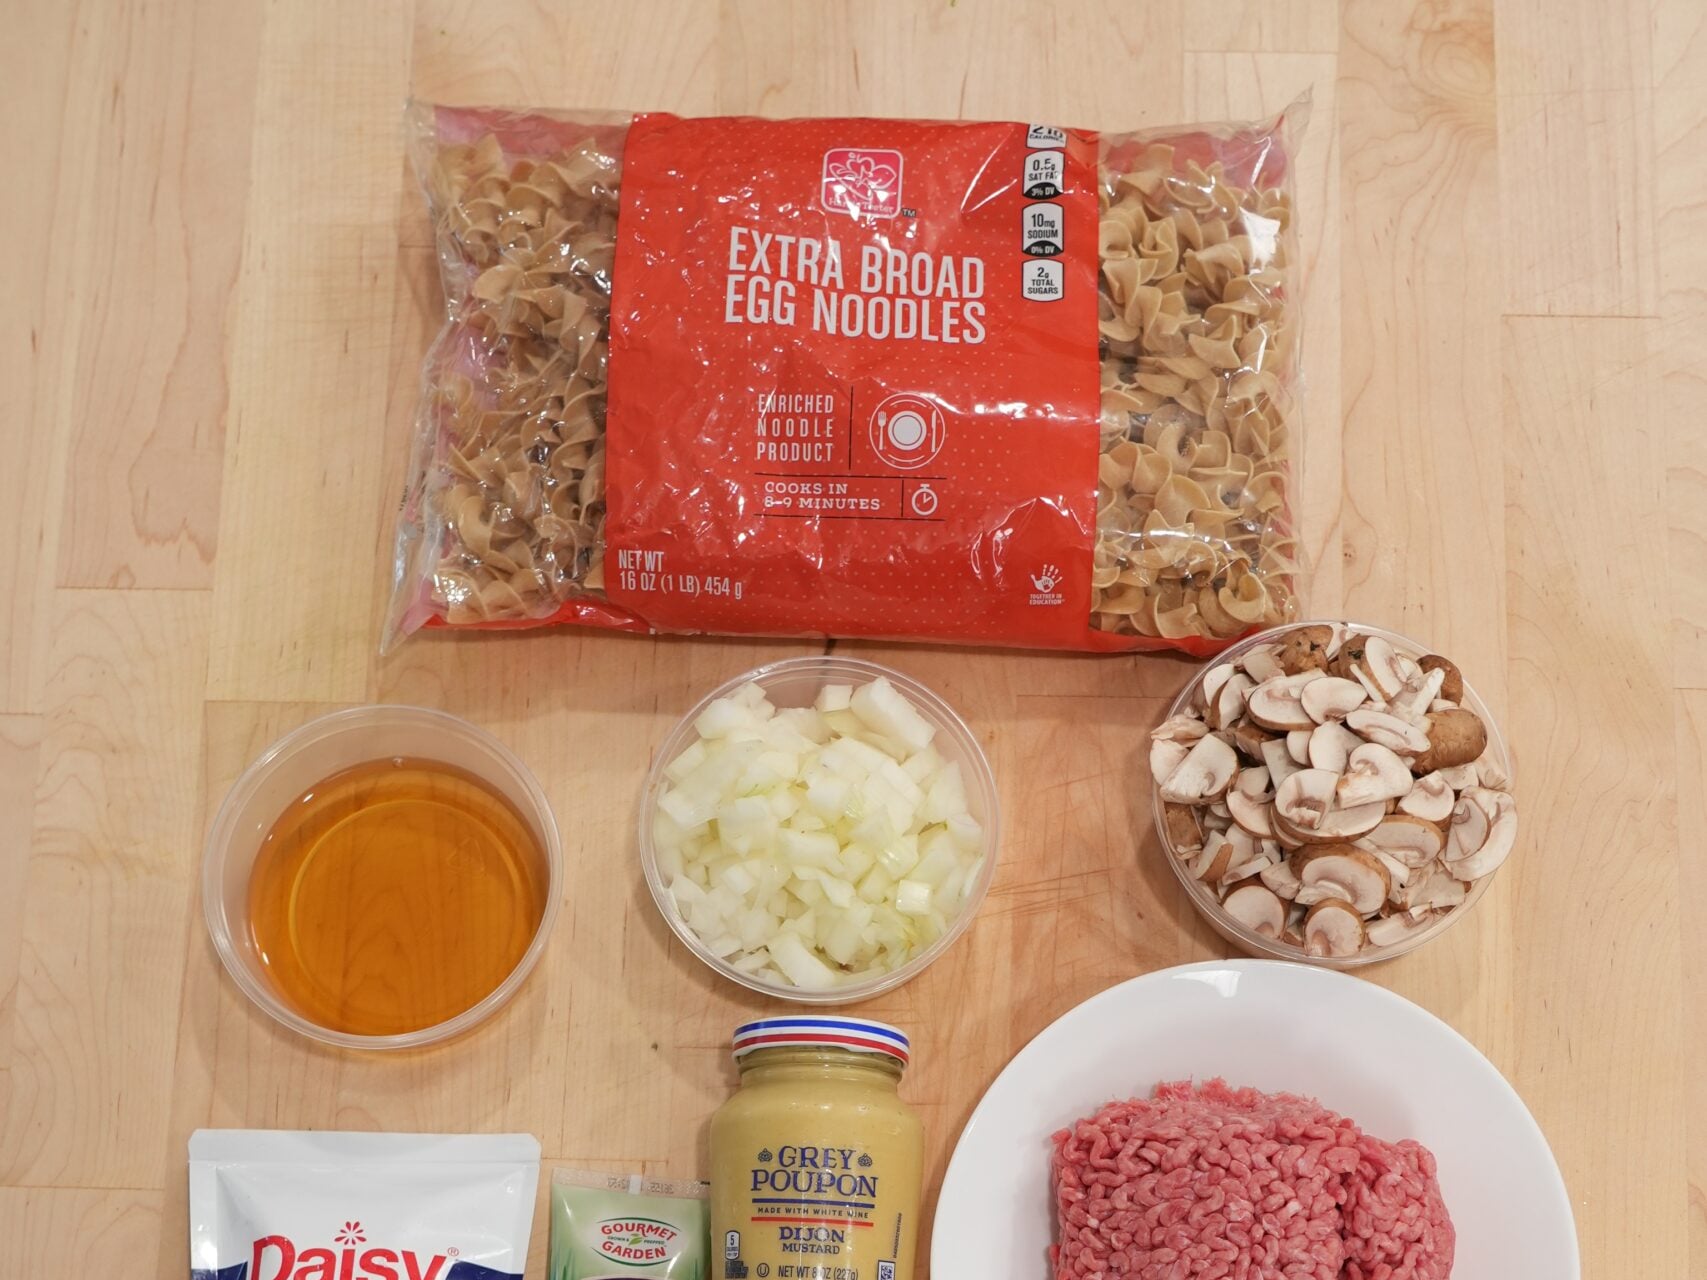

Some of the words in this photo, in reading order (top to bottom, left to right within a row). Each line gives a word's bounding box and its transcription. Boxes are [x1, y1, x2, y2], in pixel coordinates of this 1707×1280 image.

[1028, 173, 1043, 181] SAT
[1031, 213, 1055, 228] 10mg
[1028, 229, 1058, 239] SODIUM
[729, 226, 844, 290] EXTRA
[860, 245, 985, 299] BROAD
[1037, 267, 1049, 279] 2g
[725, 274, 796, 326] EGG
[812, 288, 986, 344] NOODLES
[758, 393, 834, 414] ENRICHED
[757, 416, 833, 438] NOODLE
[756, 442, 834, 462] PRODUCT
[764, 481, 823, 495] COOKS
[828, 483, 848, 495] IN
[799, 497, 880, 510] MINUTES
[618, 549, 642, 570] NET
[644, 551, 664, 572] WT
[620, 570, 637, 590] 16
[640, 572, 656, 591] OZ
[661, 574, 673, 594] (1
[679, 575, 700, 598] LB)
[704, 576, 730, 596] 454
[735, 582, 742, 599] g
[778, 1146, 856, 1170] GREY
[750, 1169, 879, 1198] POUPON
[847, 1210, 869, 1219] WINE
[601, 1222, 677, 1241] GOURMET
[778, 1226, 845, 1243] DIJON
[602, 1241, 667, 1260] GARDEN
[782, 1243, 840, 1255] MUSTARD
[778, 1265, 794, 1278] NET
[797, 1266, 810, 1279] WT
